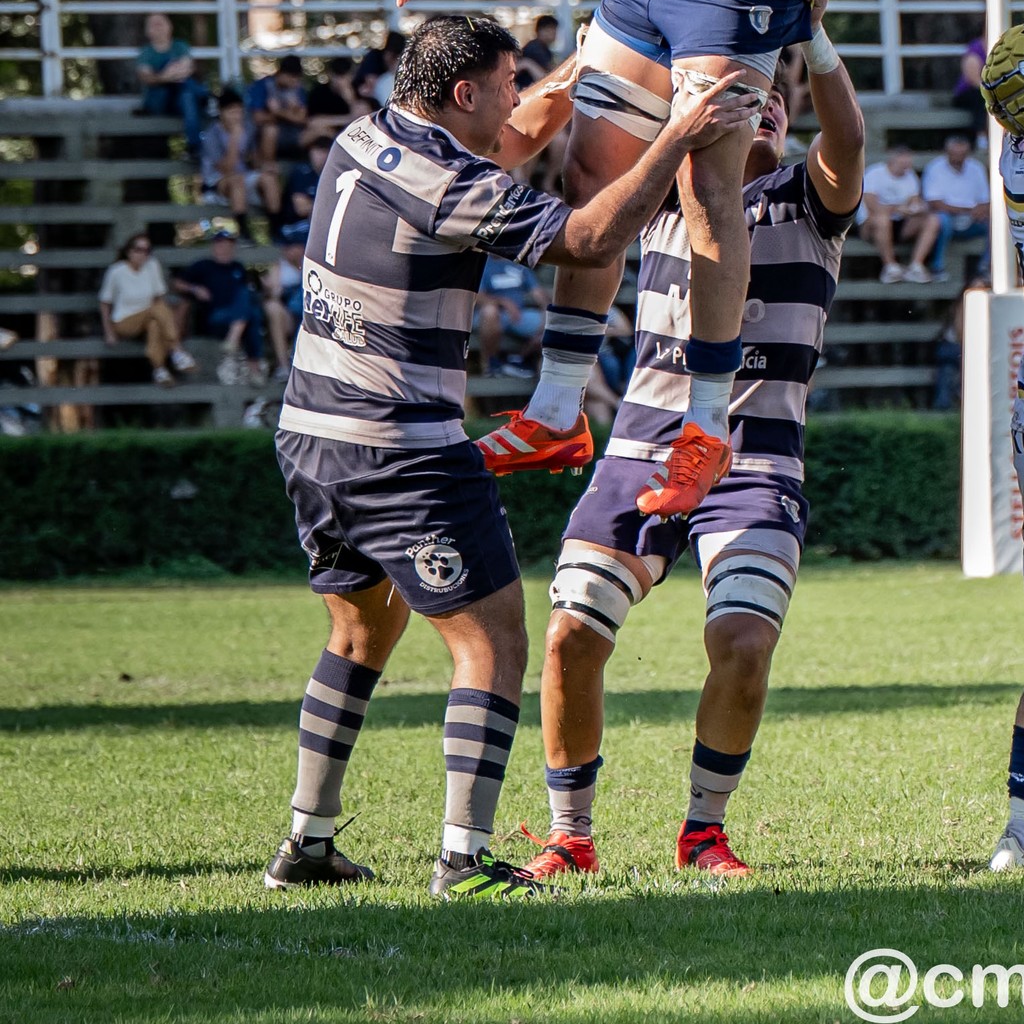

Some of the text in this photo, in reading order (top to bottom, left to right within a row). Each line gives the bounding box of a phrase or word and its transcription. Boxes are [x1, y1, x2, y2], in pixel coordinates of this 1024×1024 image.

[325, 168, 362, 267] 1
[324, 288, 362, 312] GRUPO
[405, 535, 456, 559] Panther
